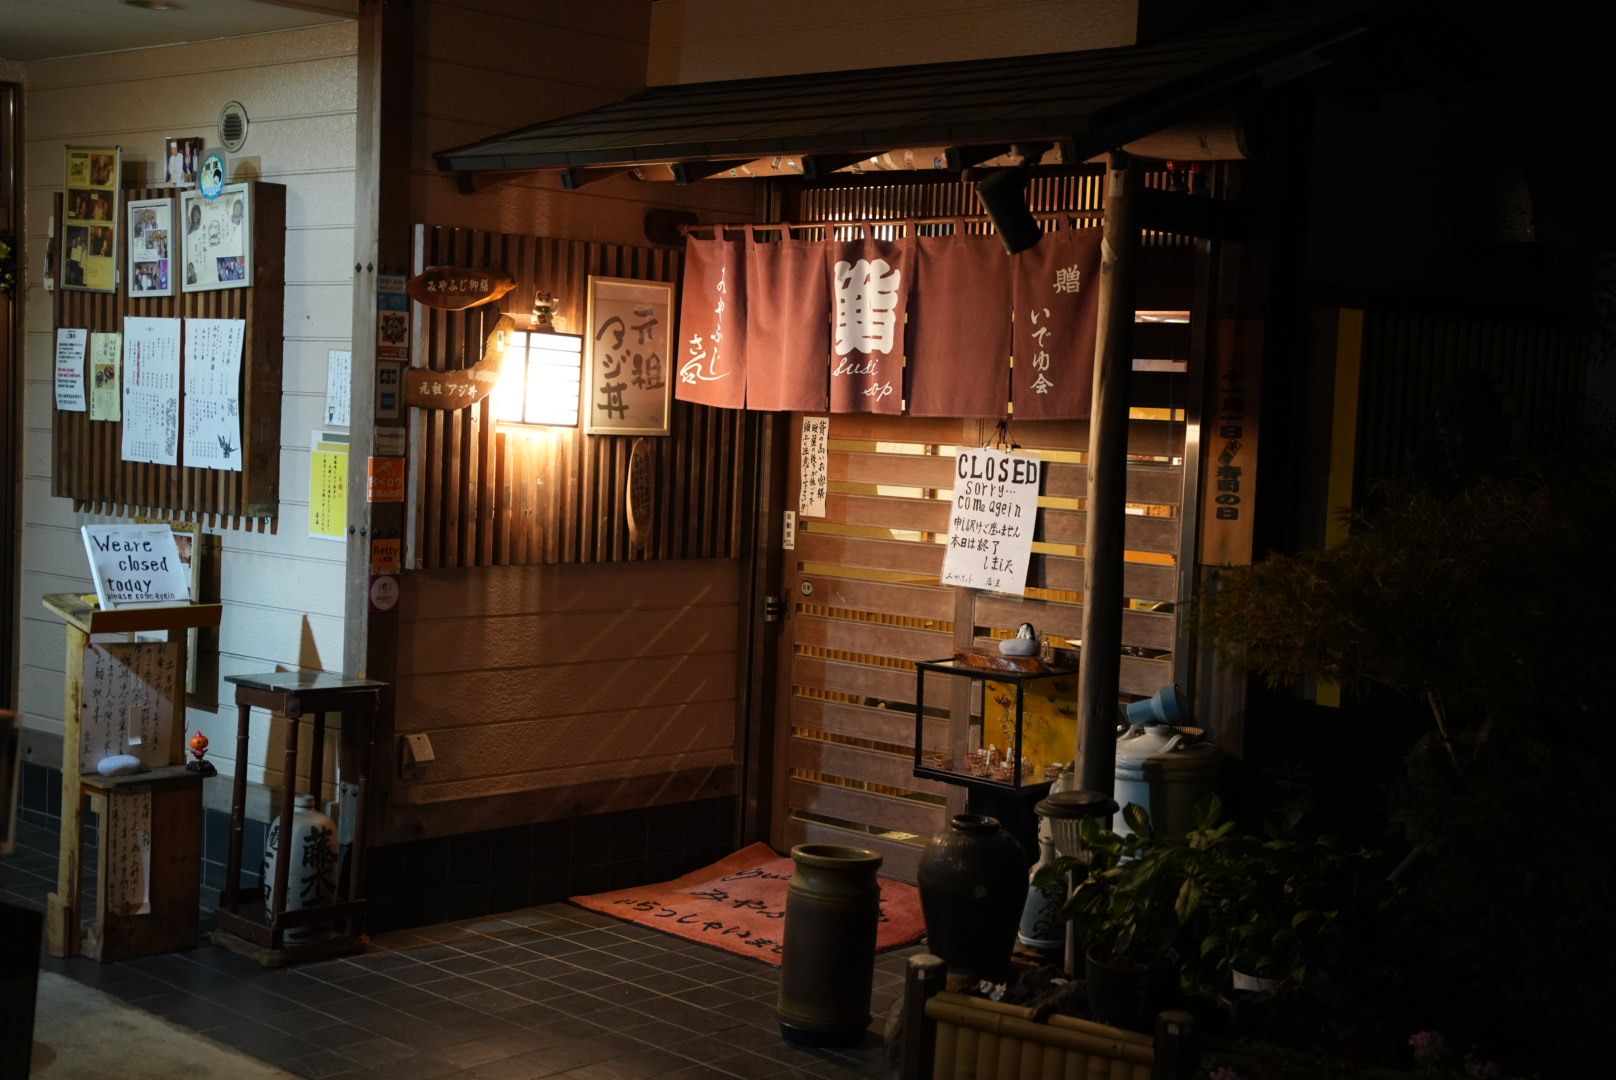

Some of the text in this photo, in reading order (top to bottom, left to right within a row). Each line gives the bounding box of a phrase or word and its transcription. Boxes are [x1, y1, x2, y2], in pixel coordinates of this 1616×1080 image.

[1053, 264, 1082, 294] 贈
[1030, 307, 1055, 395] いでゆ会
[958, 453, 1038, 485] CLOSED
[374, 546, 399, 557] Retty
[950, 534, 1001, 556] 本日は終了
[118, 555, 169, 573] closed
[107, 578, 153, 593] today
